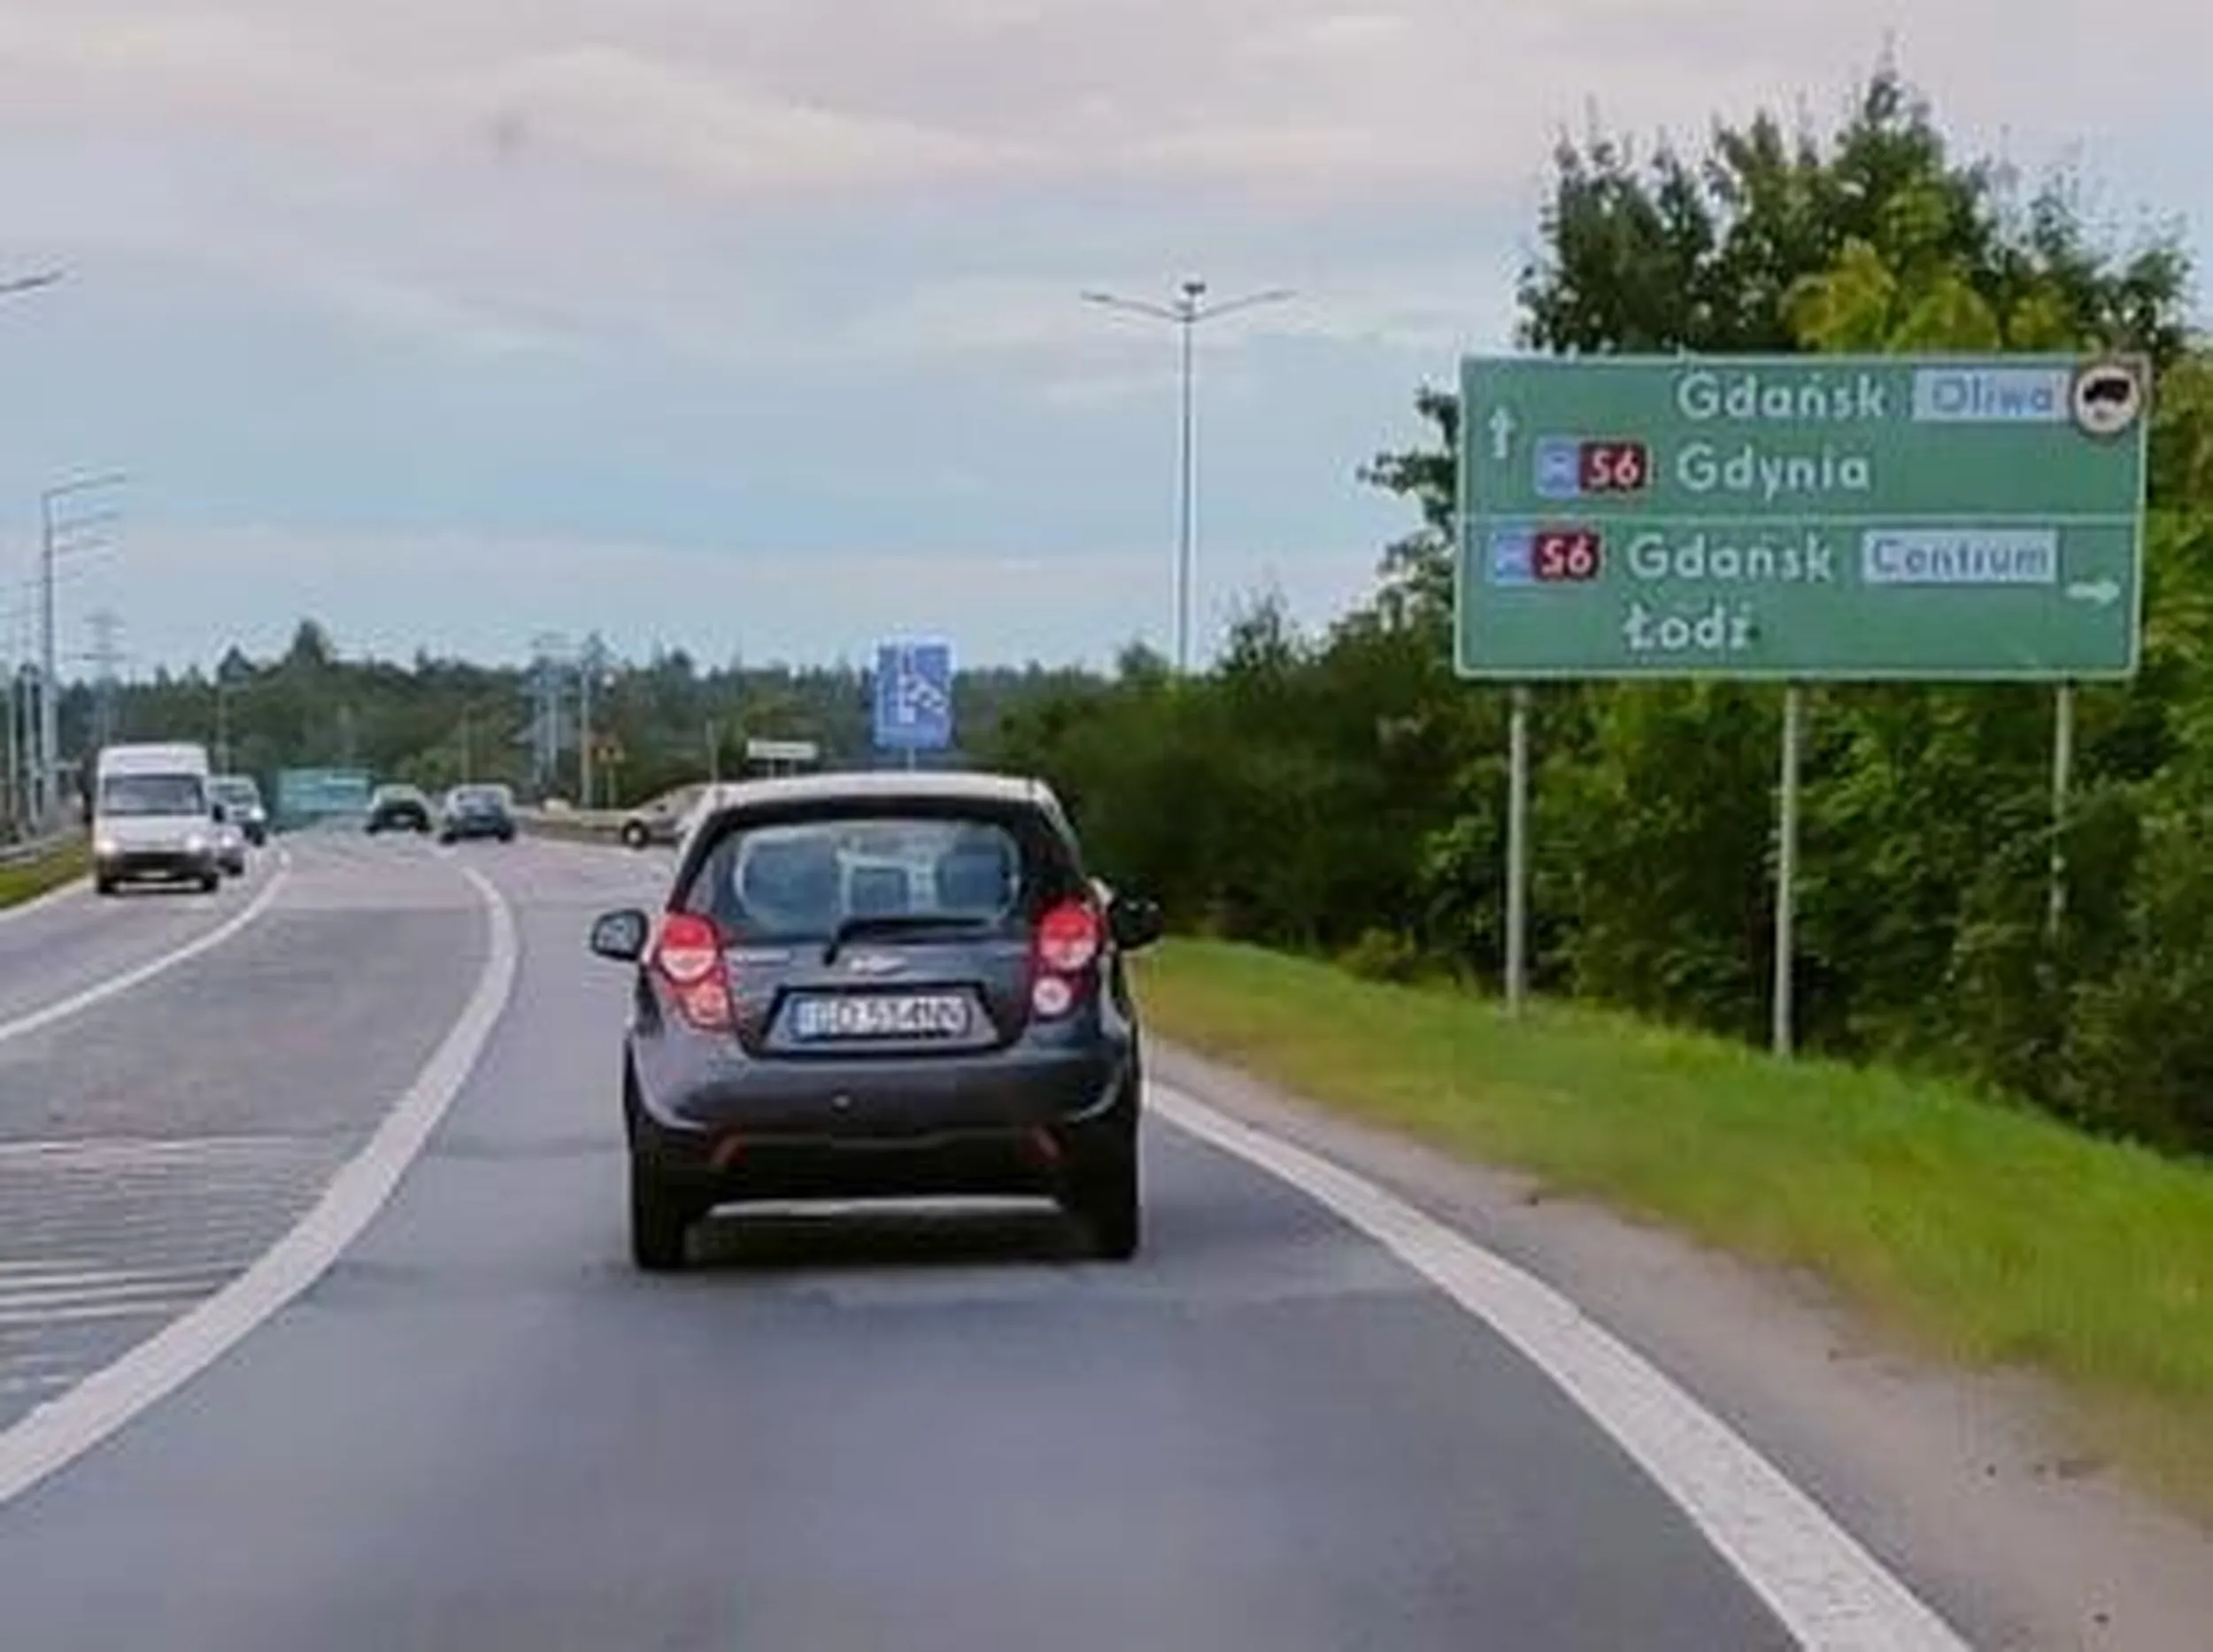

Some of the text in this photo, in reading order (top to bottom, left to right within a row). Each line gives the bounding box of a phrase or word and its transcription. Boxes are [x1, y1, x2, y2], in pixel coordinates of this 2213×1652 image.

[1677, 373, 2054, 419] Gdańsk Oliwa
[1587, 443, 1871, 500] S6 Gdynia
[1541, 534, 1592, 575] S6
[1873, 538, 2049, 574] Centrum
